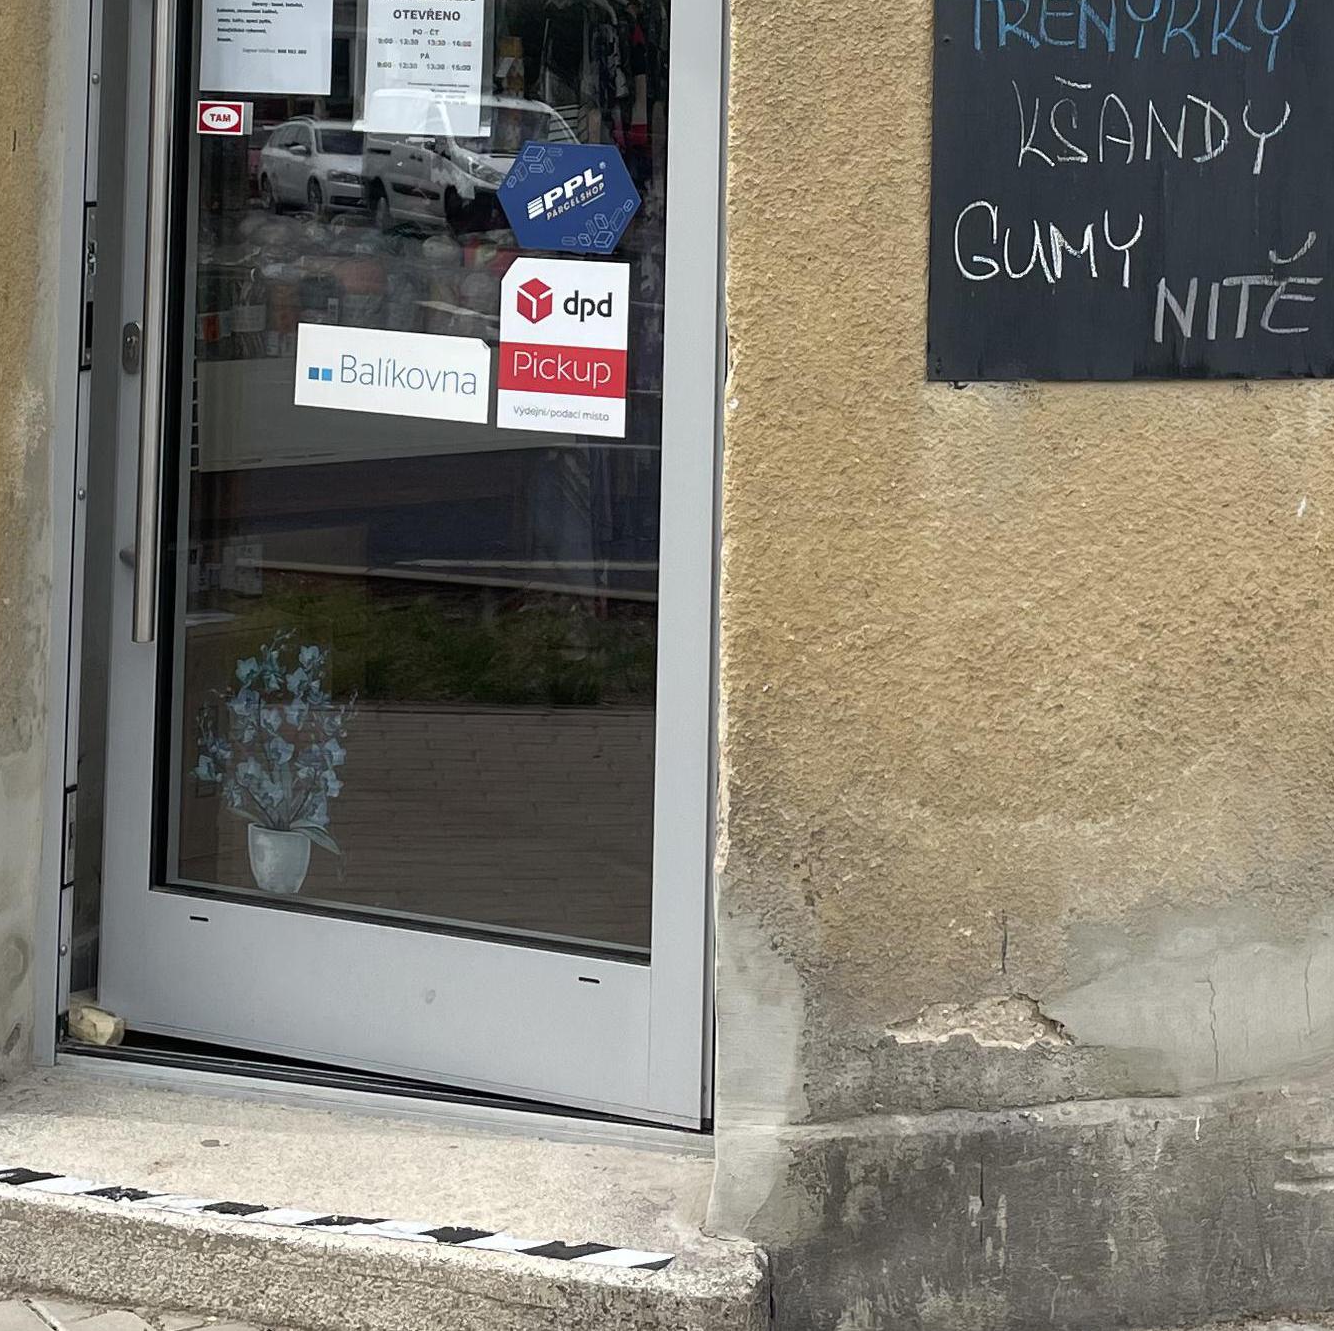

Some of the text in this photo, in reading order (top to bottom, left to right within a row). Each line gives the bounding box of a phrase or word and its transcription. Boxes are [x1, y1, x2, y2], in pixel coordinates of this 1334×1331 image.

[393, 8, 461, 21] OTEVŘENO
[209, 113, 231, 122] TAM
[1011, 75, 1291, 174] KŠANDY
[544, 168, 604, 210] PPL
[546, 182, 605, 221] PARCELSHOP
[953, 200, 1143, 288] GUMY
[563, 290, 613, 322] dpd
[340, 354, 477, 396] Balíkovna
[513, 350, 612, 389] Pickup
